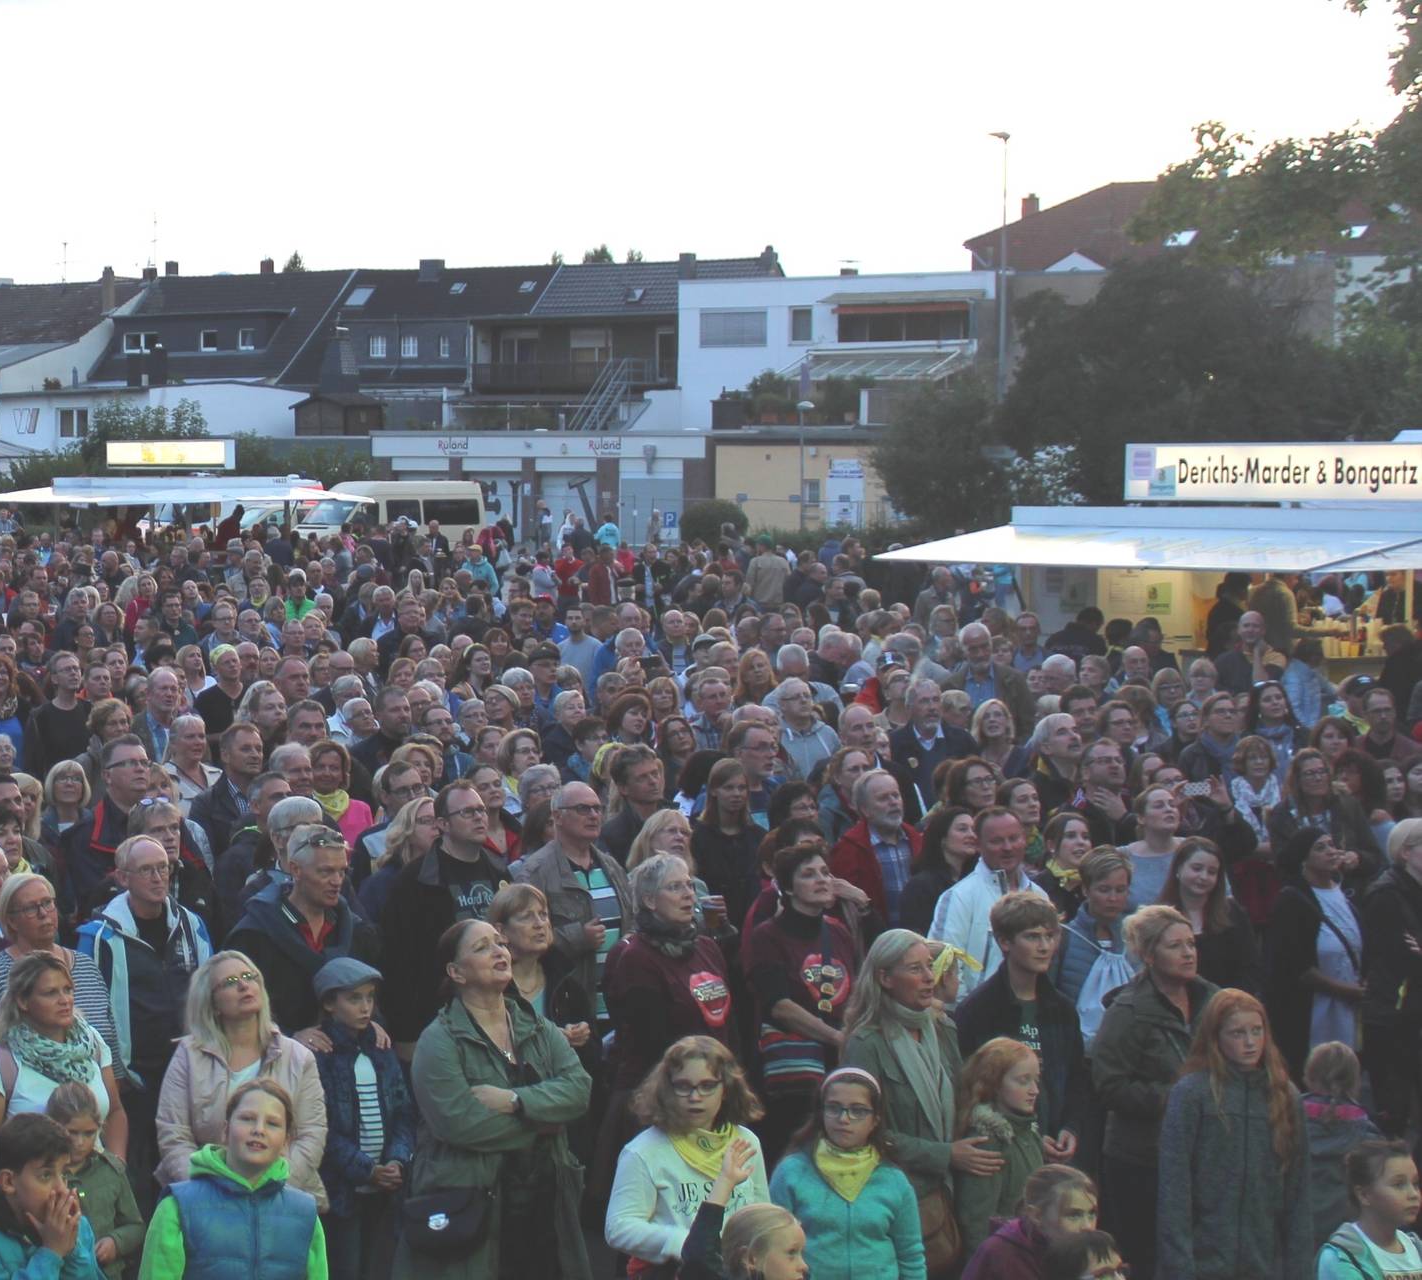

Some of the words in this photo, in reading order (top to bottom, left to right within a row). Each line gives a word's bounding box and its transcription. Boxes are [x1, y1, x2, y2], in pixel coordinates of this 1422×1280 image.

[1178, 454, 1310, 484] Derichs-Marder
[1317, 460, 1326, 484] &
[1334, 457, 1418, 493] Bongartz
[666, 513, 674, 526] P
[679, 1183, 698, 1202] JE
